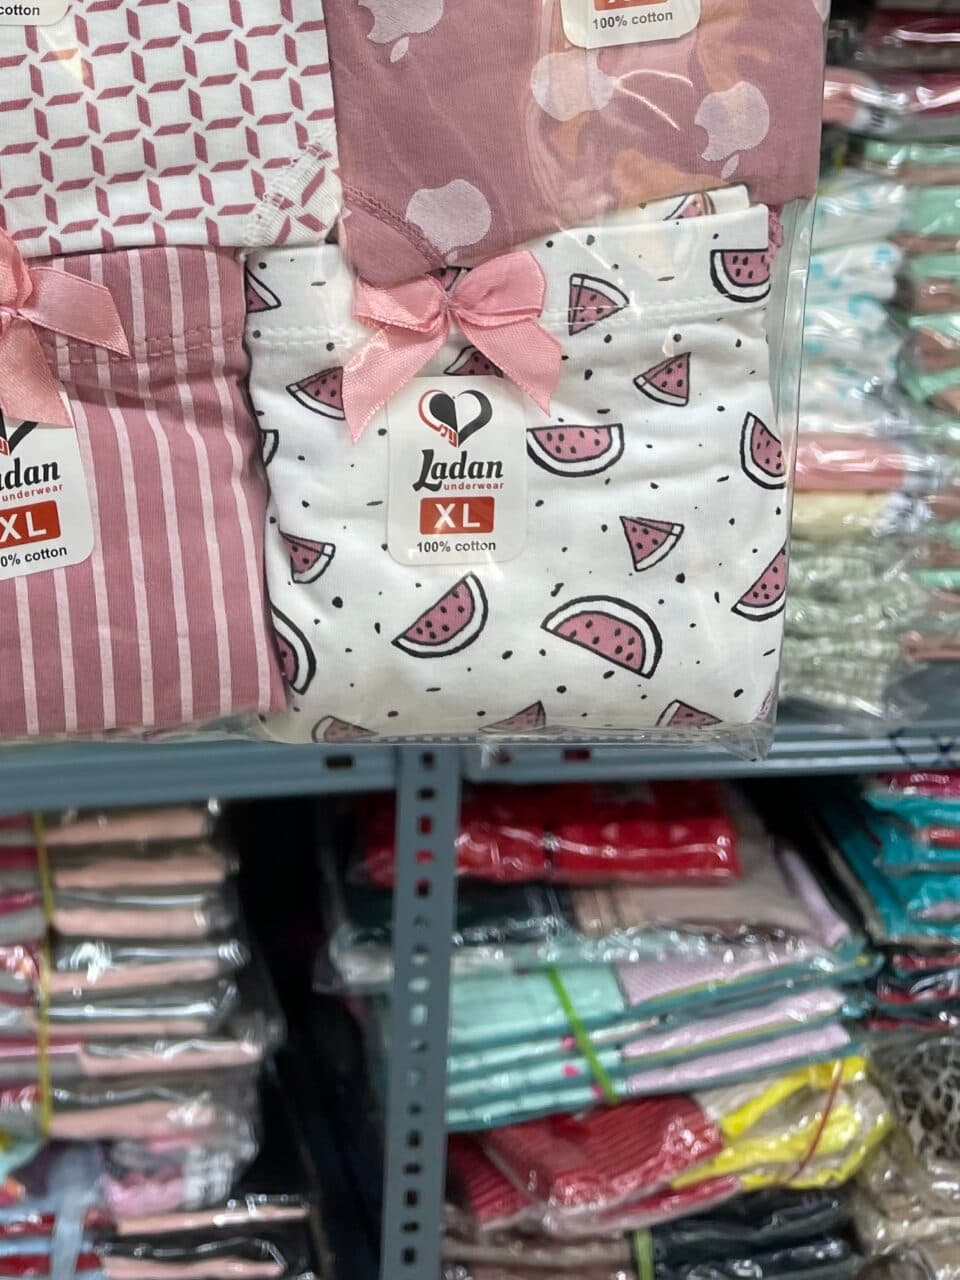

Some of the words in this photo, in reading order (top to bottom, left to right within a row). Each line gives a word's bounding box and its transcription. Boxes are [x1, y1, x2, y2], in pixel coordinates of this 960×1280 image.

[592, 15, 628, 29] 100%
[631, 11, 673, 25] cotton
[412, 449, 504, 492] Ladan
[2, 484, 63, 502] underwear
[444, 482, 504, 491] underwear
[434, 503, 481, 528] XL
[25, 546, 67, 563] cotton
[416, 541, 451, 553] 100%
[455, 540, 496, 552] cotton
